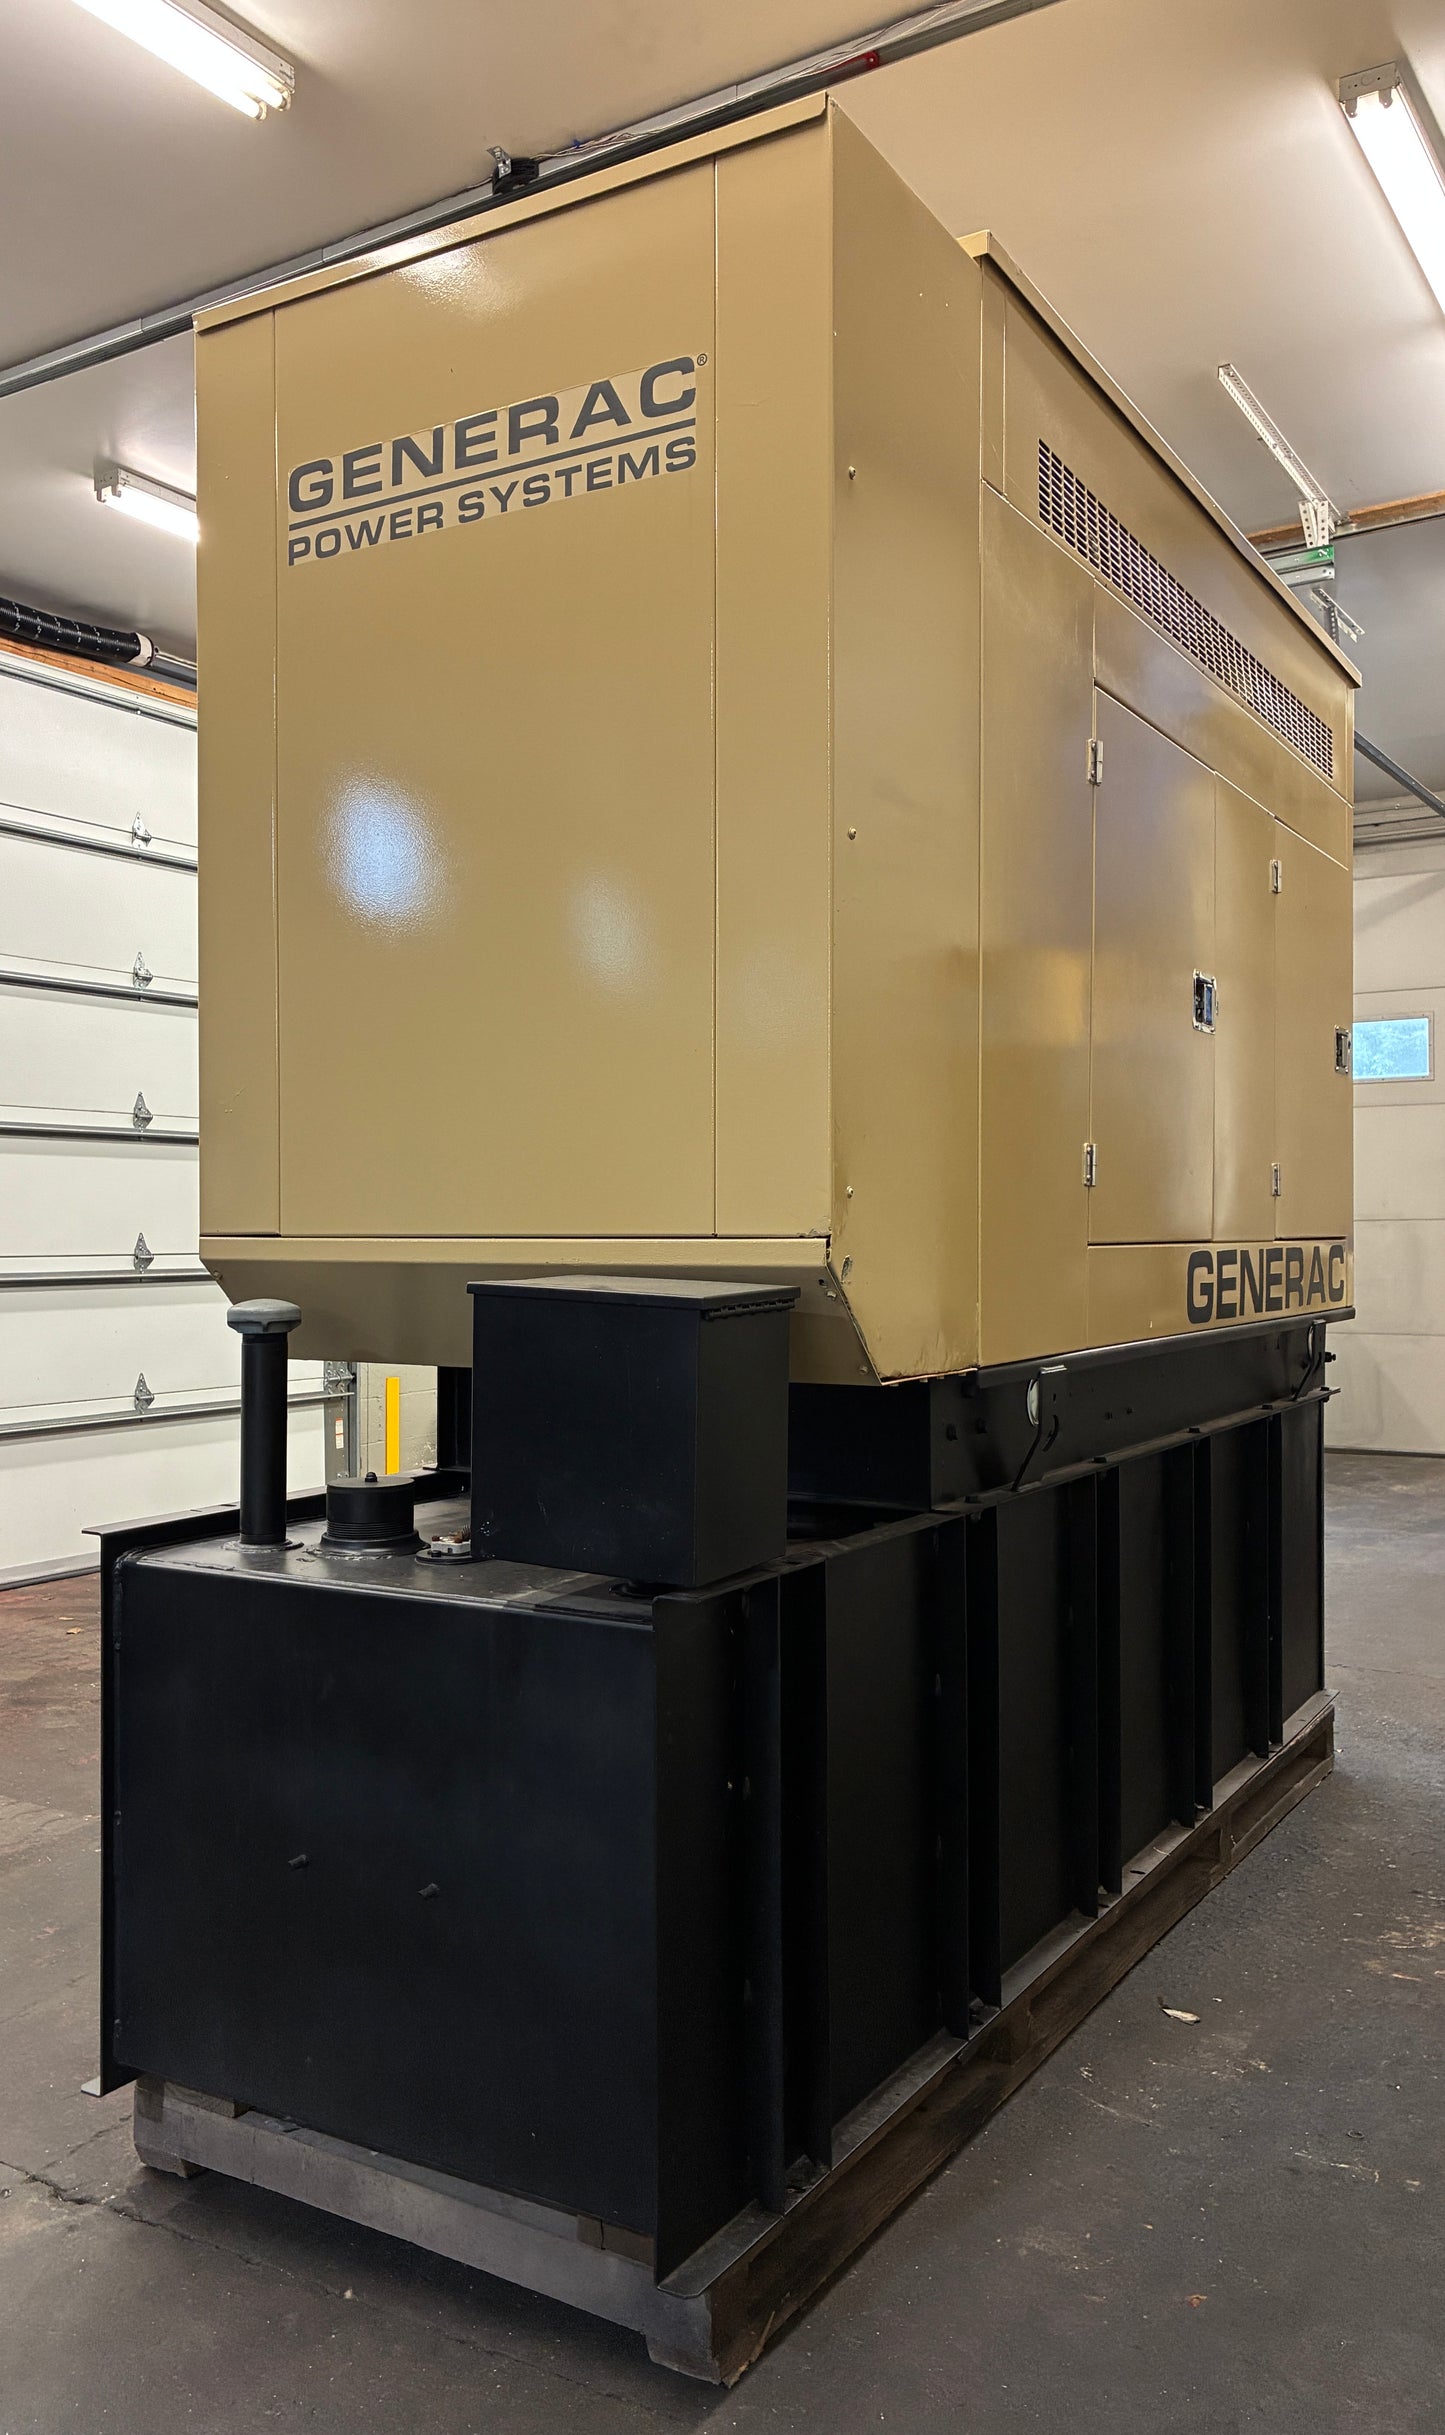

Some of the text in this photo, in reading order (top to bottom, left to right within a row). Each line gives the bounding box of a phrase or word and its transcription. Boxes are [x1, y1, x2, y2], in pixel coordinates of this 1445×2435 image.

[288, 435, 697, 567] POWER SYSTEMS
[1187, 1244, 1345, 1324] GENERAC
